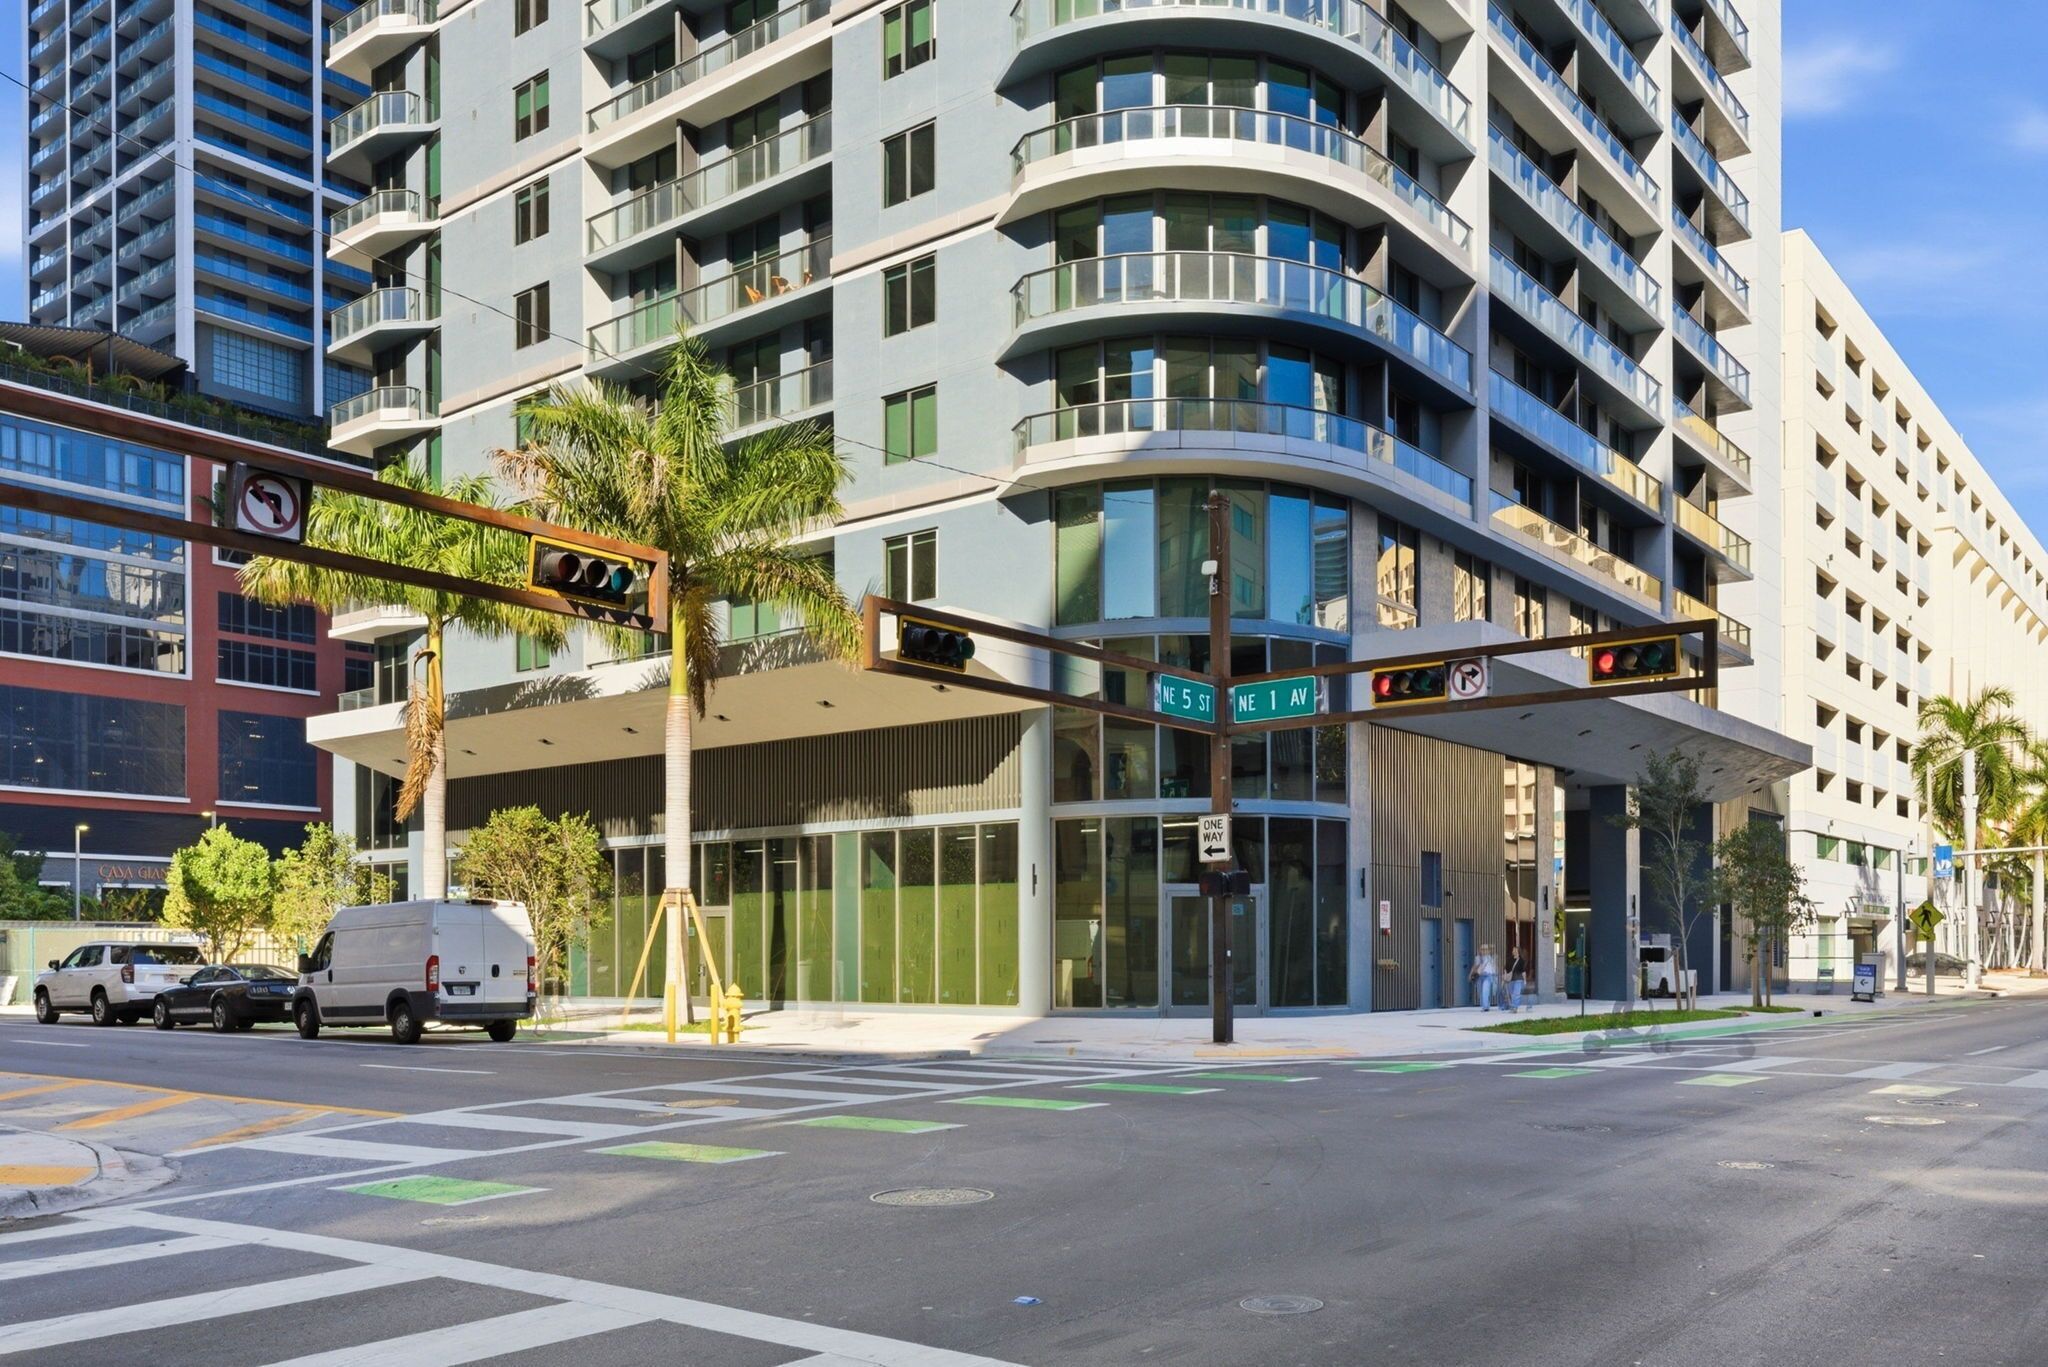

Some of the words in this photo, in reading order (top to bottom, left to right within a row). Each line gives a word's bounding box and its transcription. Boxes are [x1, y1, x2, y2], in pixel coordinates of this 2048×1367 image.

[1163, 685, 1175, 704] NE
[1182, 688, 1192, 709] 5
[1198, 693, 1210, 712] ST
[1238, 693, 1256, 712] NE
[1270, 690, 1276, 711] 1
[1290, 687, 1307, 706] AV
[1203, 819, 1223, 830] ONE
[1202, 831, 1223, 842] WAY
[98, 864, 133, 882] CASA
